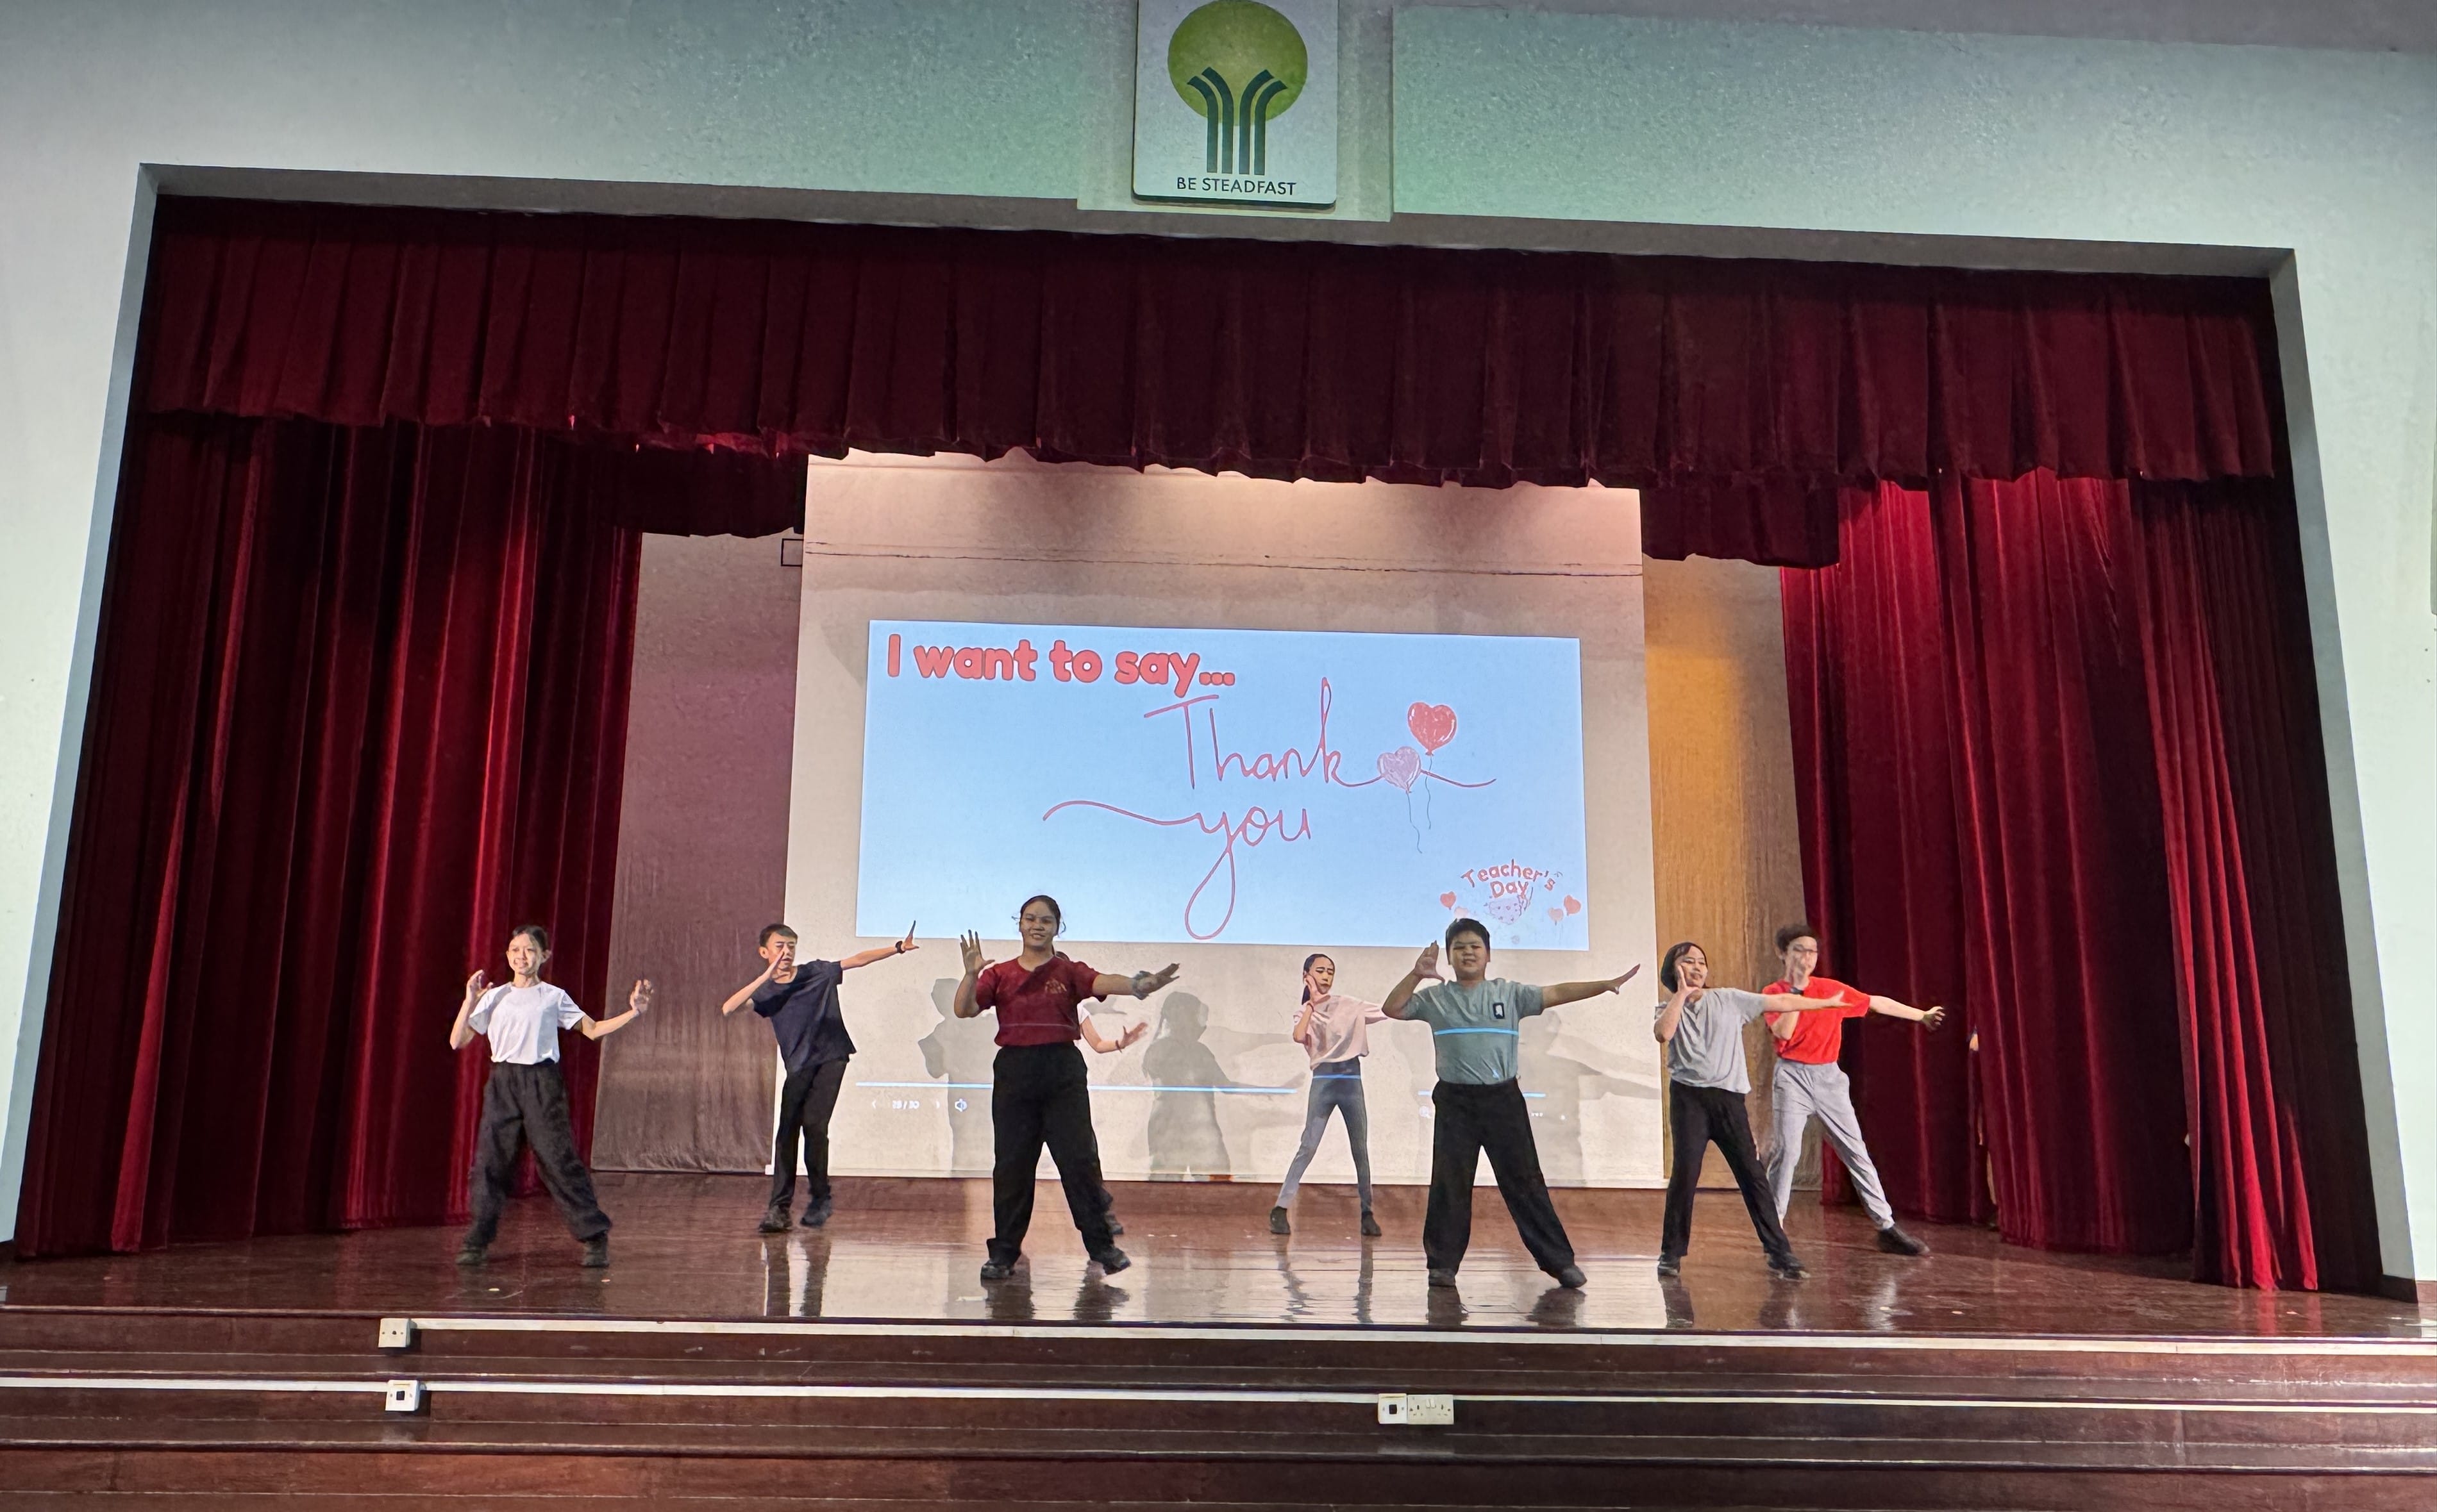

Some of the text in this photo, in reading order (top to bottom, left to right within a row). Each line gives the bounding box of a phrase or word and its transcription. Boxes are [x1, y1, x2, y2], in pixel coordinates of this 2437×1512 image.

[1177, 177, 1296, 195] BE STEADFAST
[887, 633, 1235, 697] I want to say...
[1144, 677, 1496, 790] Thank
[1043, 801, 1311, 940] you
[1461, 859, 1556, 891] Teacher's
[1490, 881, 1529, 899] Day
